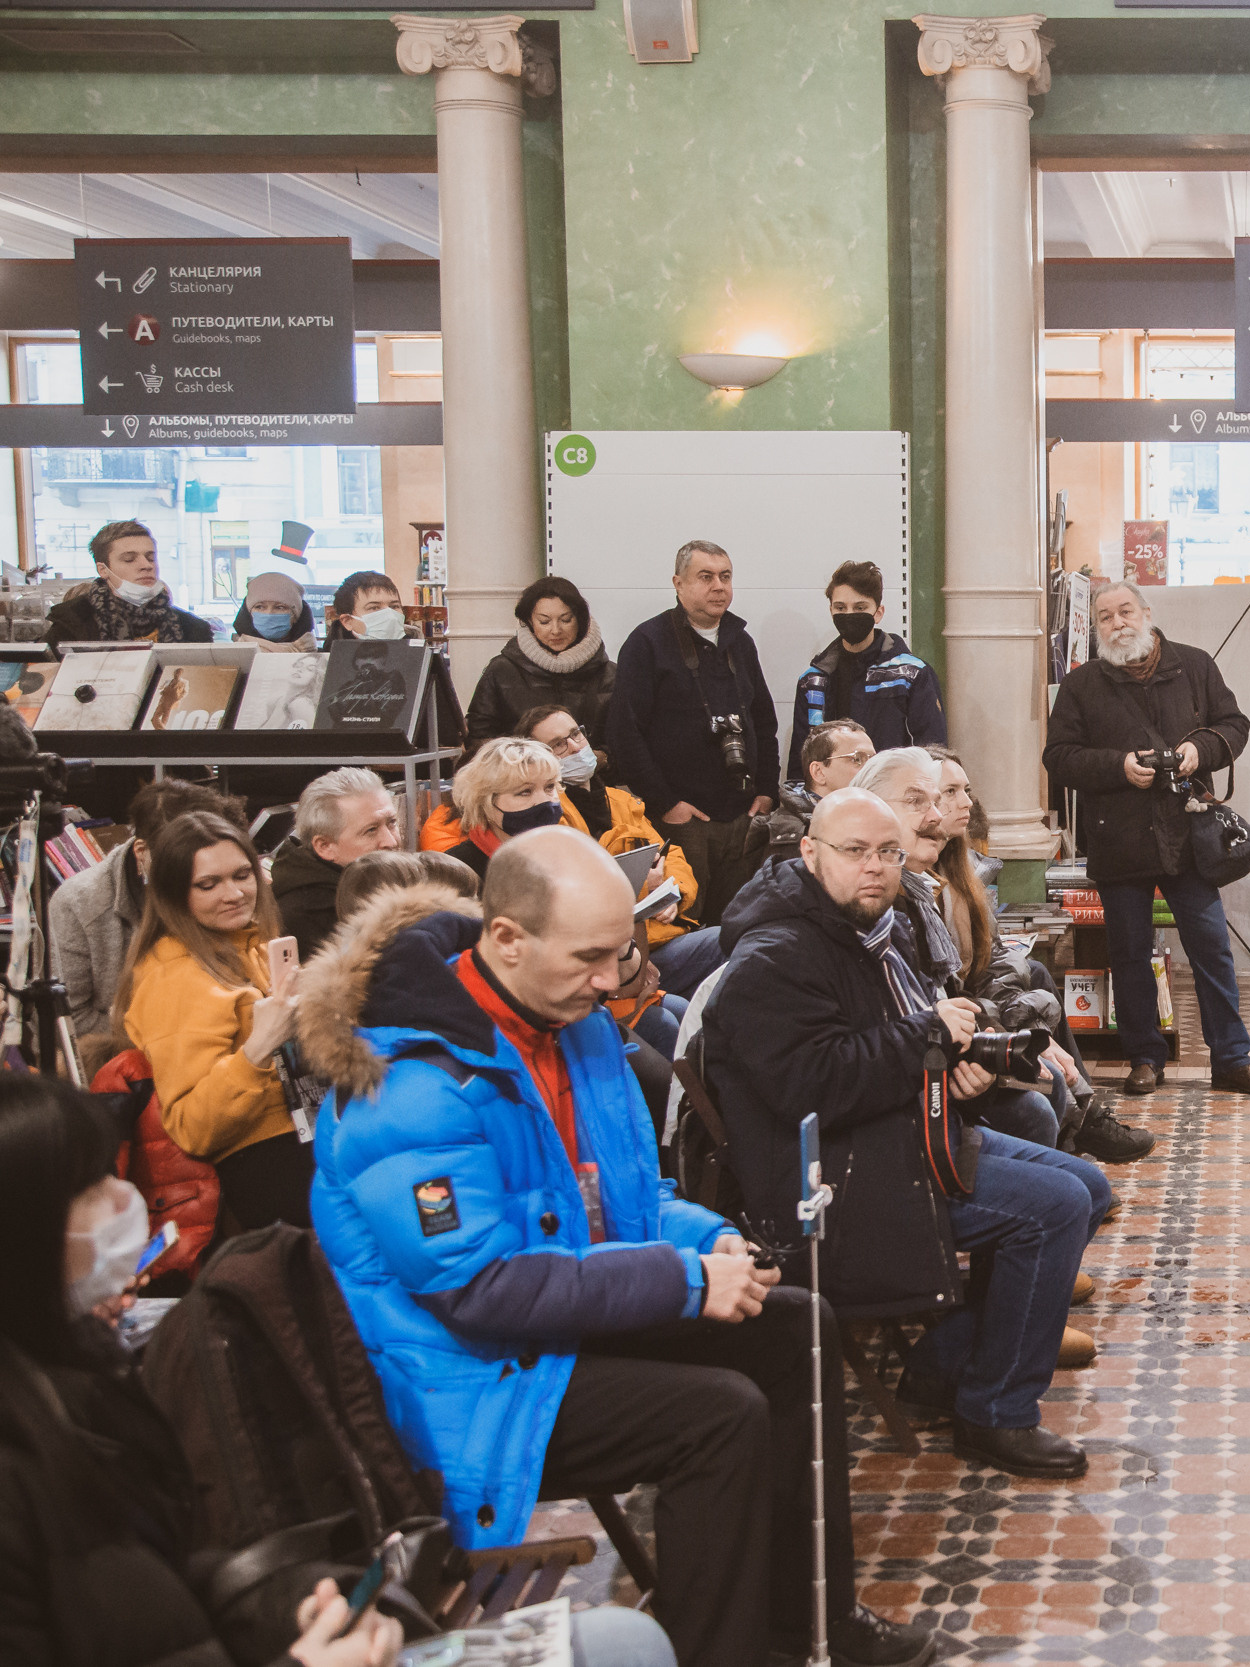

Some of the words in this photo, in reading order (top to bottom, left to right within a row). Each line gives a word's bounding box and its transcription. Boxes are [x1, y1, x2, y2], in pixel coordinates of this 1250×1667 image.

[169, 266, 262, 279] КАНЦЕЛЯРИЯ
[170, 282, 234, 295] Stationary
[172, 316, 286, 330] ПУТЕВОДИТЕЛИ,
[288, 316, 335, 328] КАРТЫ
[172, 333, 233, 345] Guidebooks,
[235, 335, 262, 345] maps
[174, 366, 221, 378] КАССЫ
[175, 381, 203, 393] Cash
[207, 381, 235, 393] desk
[149, 415, 213, 428] АЛЬБОМЫ,
[215, 415, 311, 427] ПУТЕВОДИТЕЛИ,
[313, 414, 354, 424] КАРТЫ
[149, 427, 191, 439] Albums,
[194, 427, 256, 440] guidebooks,
[259, 429, 288, 440] maps
[1128, 544, 1164, 559] -25%
[1071, 982, 1096, 992] УЧЕТ
[930, 1082, 942, 1118] Canon
